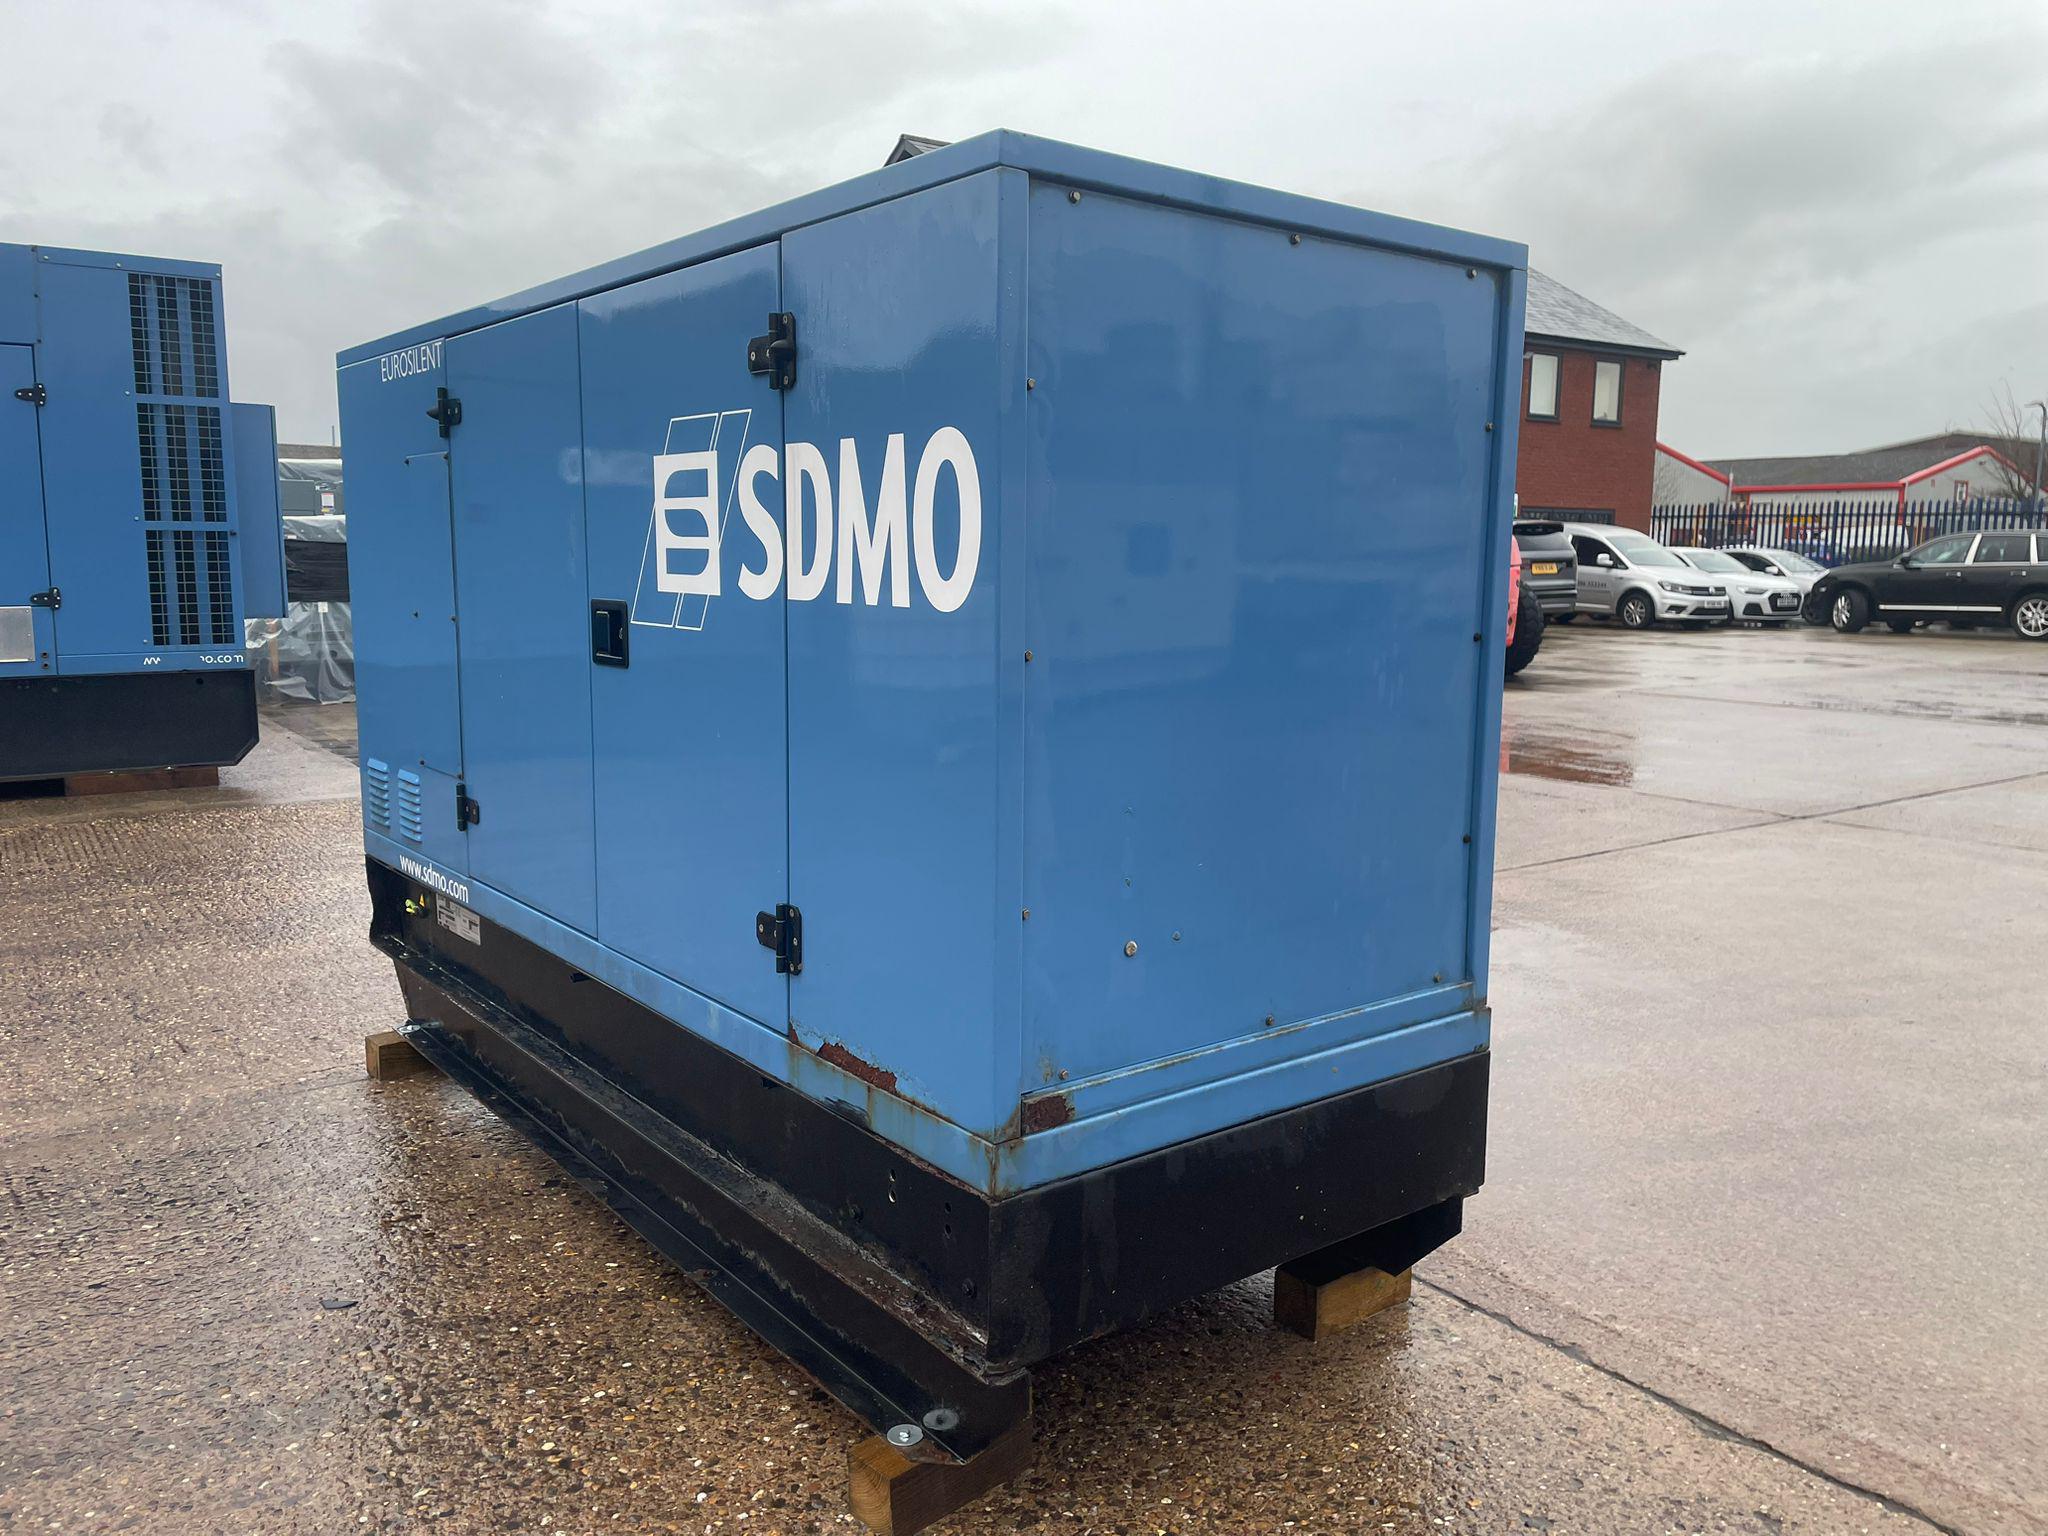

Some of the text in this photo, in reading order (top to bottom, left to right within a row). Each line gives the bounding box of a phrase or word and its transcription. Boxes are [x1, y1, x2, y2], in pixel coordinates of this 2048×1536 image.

[380, 341, 442, 382] EUROSILENT
[738, 426, 982, 612] SDMO
[399, 854, 469, 903] www.sdmo.com
